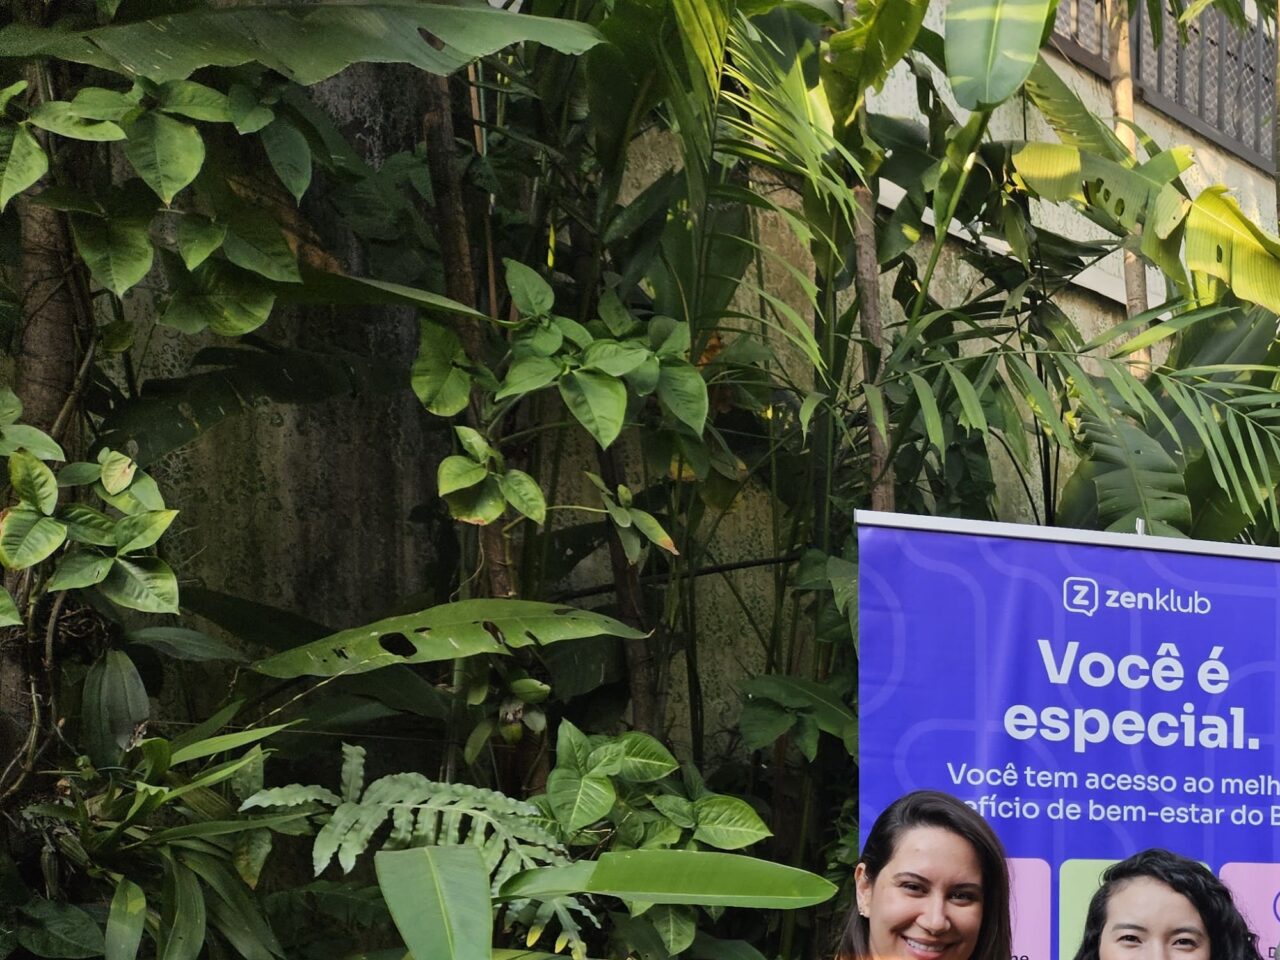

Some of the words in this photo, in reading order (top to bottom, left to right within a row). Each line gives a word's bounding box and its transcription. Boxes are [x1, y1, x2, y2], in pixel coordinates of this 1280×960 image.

[1106, 587, 1211, 614] zenklub
[1037, 639, 1185, 692] Você
[1197, 646, 1230, 694] é
[1003, 702, 1260, 753] especial.
[946, 762, 1019, 786] Você
[1024, 766, 1078, 789] tem
[1084, 770, 1178, 793] acesso
[1183, 774, 1214, 794] ao
[1046, 798, 1082, 821] de
[1088, 799, 1225, 825] bem-estar
[1230, 803, 1264, 826] do
